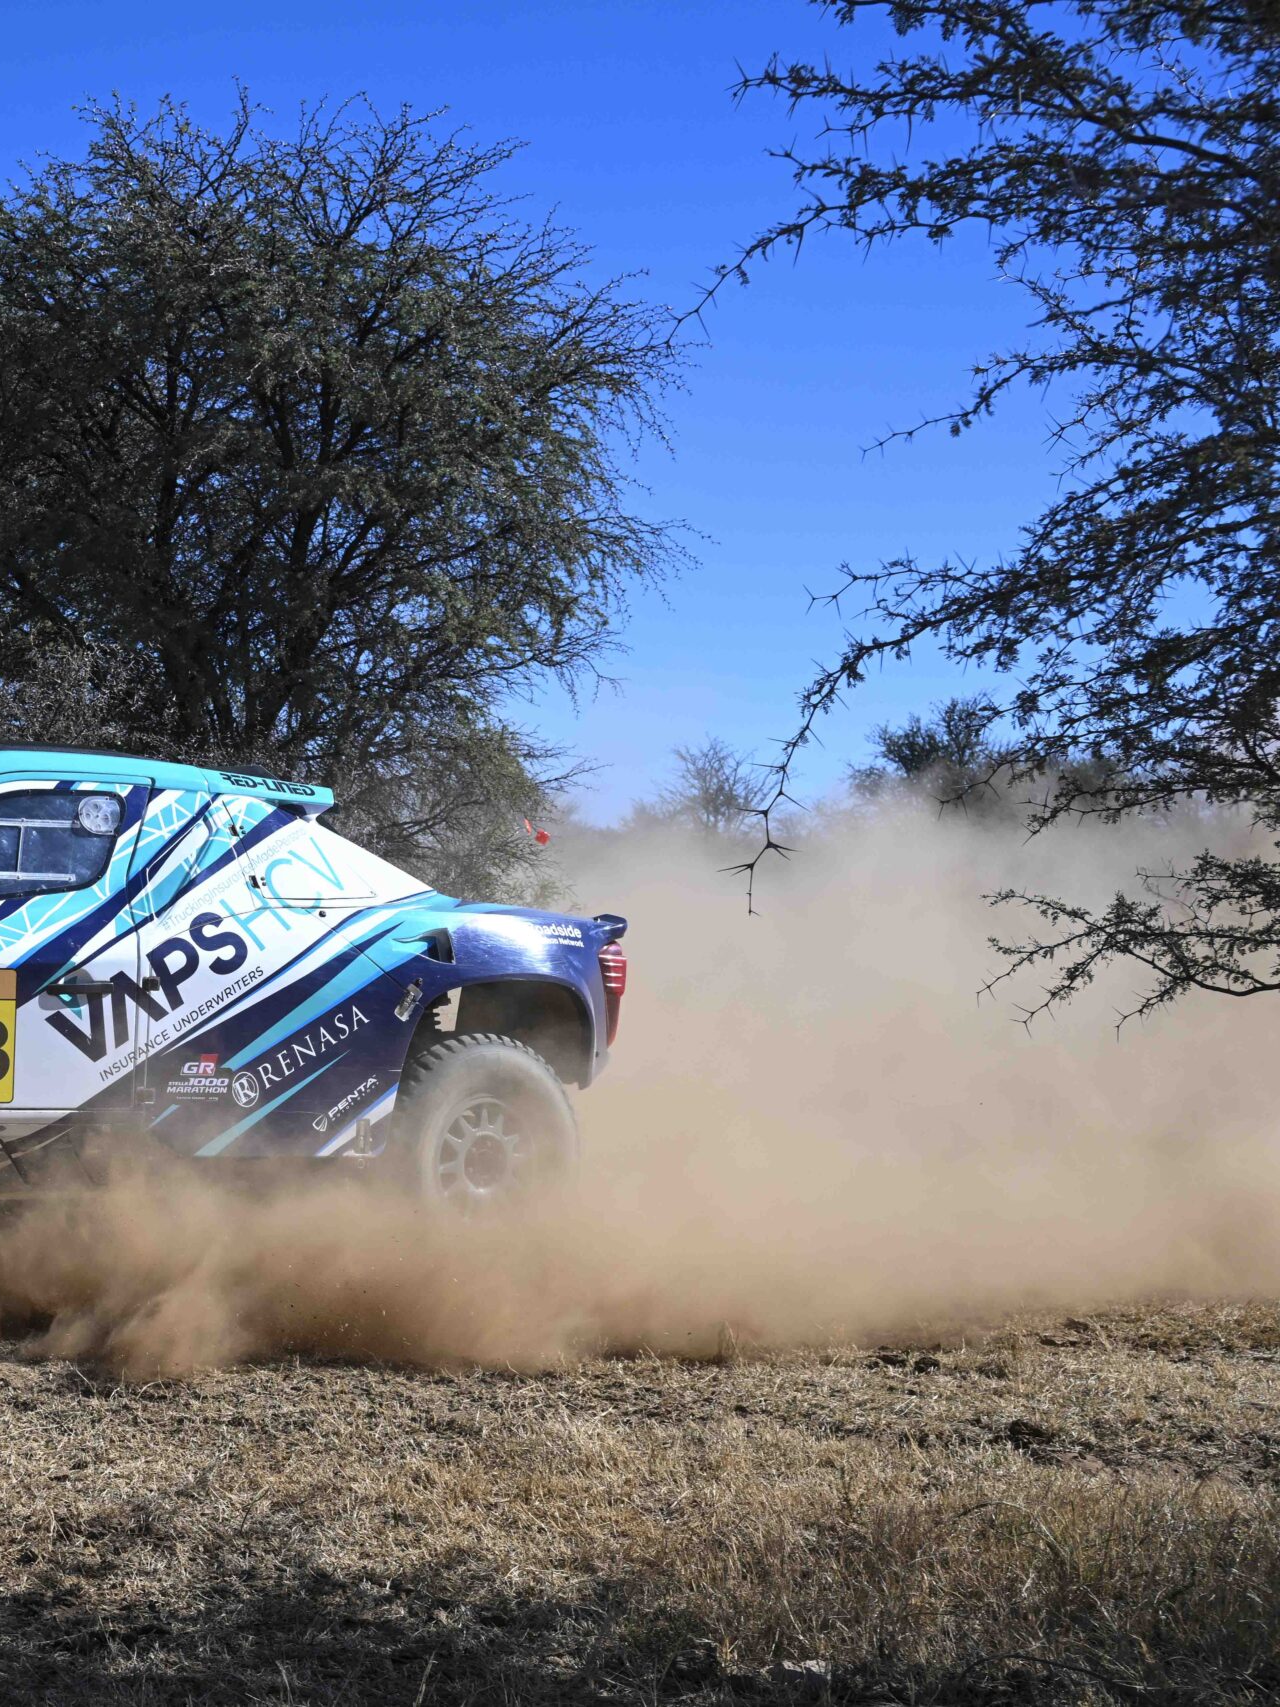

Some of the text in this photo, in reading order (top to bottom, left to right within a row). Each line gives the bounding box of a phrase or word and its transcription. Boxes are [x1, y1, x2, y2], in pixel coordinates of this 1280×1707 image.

[219, 772, 316, 797] RED-LINED
[532, 923, 582, 939] oadside
[99, 965, 265, 1083] INSURANCE UNDERWRITERS
[256, 1004, 371, 1090] RENASA
[183, 1061, 216, 1074] GR
[166, 1086, 228, 1094] MARATHON
[327, 1077, 378, 1119] PENTA
